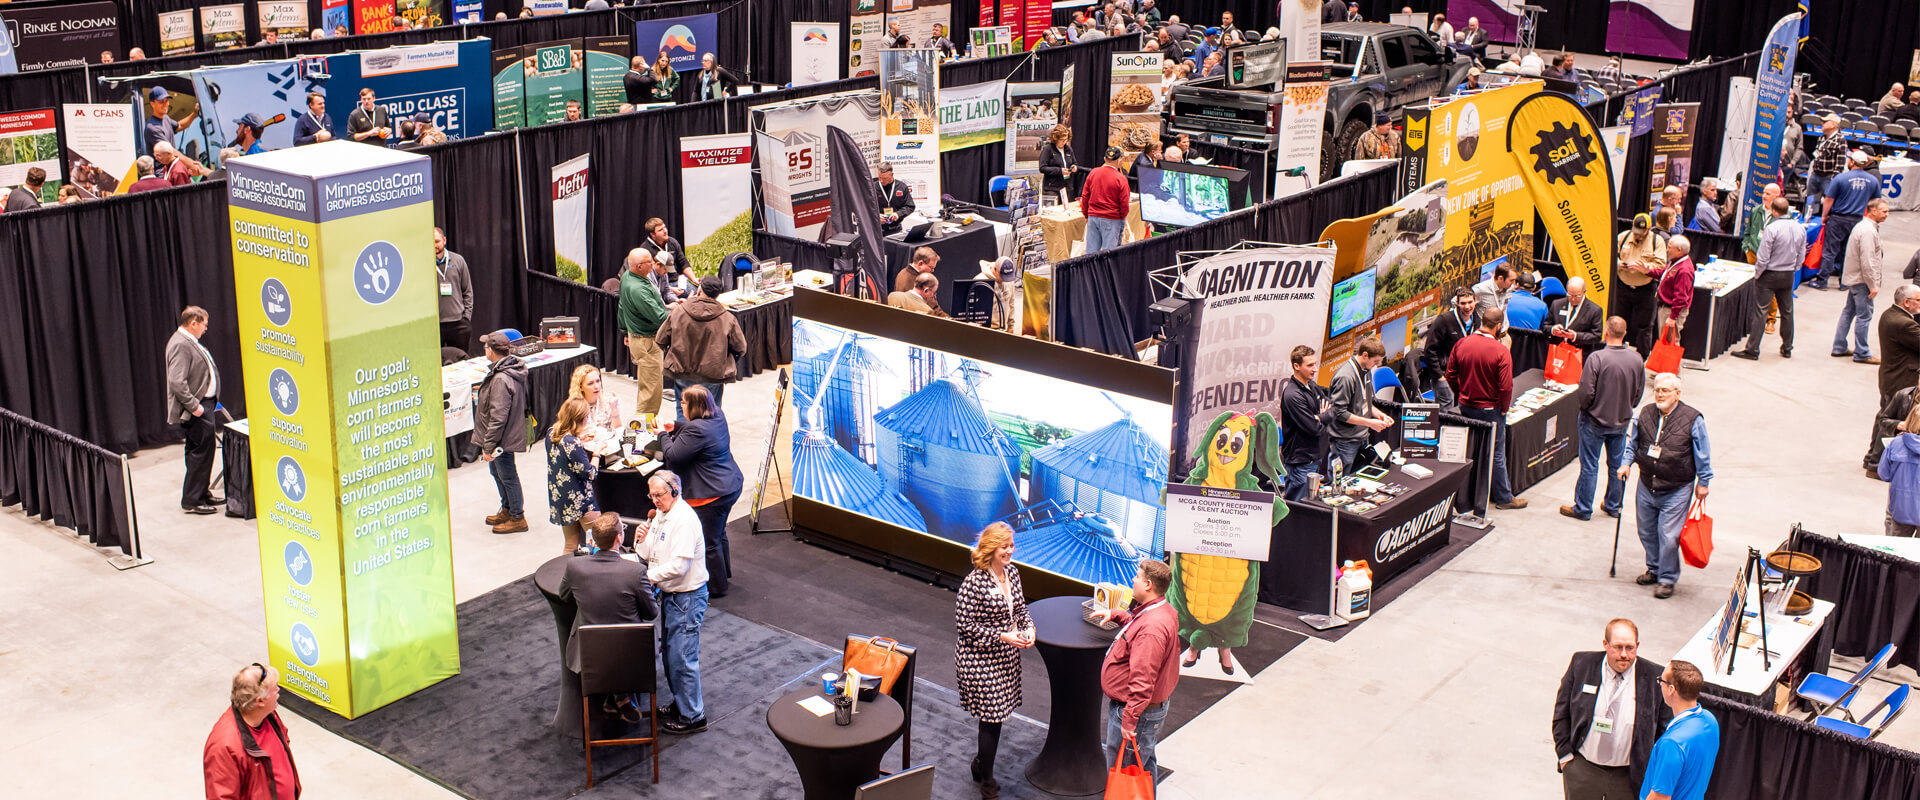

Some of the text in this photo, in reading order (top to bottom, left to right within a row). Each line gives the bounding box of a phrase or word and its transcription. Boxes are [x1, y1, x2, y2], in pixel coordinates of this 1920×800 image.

[214, 10, 232, 18] Max
[361, 16, 393, 34] SMART
[362, 3, 390, 22] BANK
[402, 6, 426, 20] GROW
[24, 17, 116, 34] RINKE NOONAN
[22, 62, 44, 71] Firmly
[542, 48, 566, 69] SB&B
[1117, 56, 1158, 68] SunOpta
[94, 110, 124, 118] CFANS
[381, 95, 456, 116] ORLD CLASS
[940, 104, 962, 124] THE
[966, 98, 1000, 120] LAND
[0, 120, 33, 128] MINNESOTA
[1409, 130, 1424, 138] ETS
[689, 148, 744, 158] MAXIMIZE
[697, 156, 737, 166] YIELDS
[784, 148, 812, 170] &S
[1548, 138, 1577, 163] soil
[1552, 152, 1581, 169] WARRIOR
[230, 171, 306, 200] MinnesotaCorn
[325, 172, 423, 200] MinnesotaCorn
[558, 172, 586, 198] Hefty
[1409, 156, 1418, 194] YSTEMS
[232, 188, 306, 212] GROWERS ASSOCIATION
[326, 184, 424, 212] GROWERS ASSOCIATION
[1446, 194, 1462, 216] NEW
[1462, 188, 1480, 210] ZONE
[1480, 184, 1490, 202] OF
[1490, 174, 1524, 199] OPPORTUN
[234, 219, 309, 248] committed to
[236, 238, 310, 268] conservation
[1557, 200, 1606, 293] SoilWarrior.com
[1204, 260, 1323, 300] AGNITION
[1210, 297, 1238, 309] HEALTHIER
[1254, 293, 1290, 302] HEALTHIER
[261, 327, 296, 346] promote
[1201, 313, 1275, 346] HARD
[256, 341, 304, 367] sustainability
[355, 356, 410, 386] Our goal:
[1225, 360, 1290, 378] SACRIFI
[346, 408, 374, 428] corn
[377, 392, 422, 418] farmers
[272, 416, 304, 436] support
[350, 426, 372, 446] will
[374, 412, 421, 438] become
[269, 430, 308, 452] innovation
[361, 432, 413, 460] the most
[341, 442, 434, 487] sustainable and
[341, 462, 436, 505] environmentally
[275, 499, 312, 524] advocate
[356, 484, 424, 519] responsible
[1226, 502, 1263, 511] RECEPTION
[269, 509, 320, 541] best practices
[354, 502, 428, 539] corn farmers
[1194, 522, 1214, 530] Opens
[1386, 490, 1456, 554] AGNITION
[376, 524, 410, 549] in the
[1202, 540, 1232, 548] Reception
[353, 535, 434, 576] United States.
[284, 595, 318, 618] new uses
[288, 584, 312, 604] foster
[286, 660, 329, 690] strengthen
[286, 672, 331, 704] partnerships
